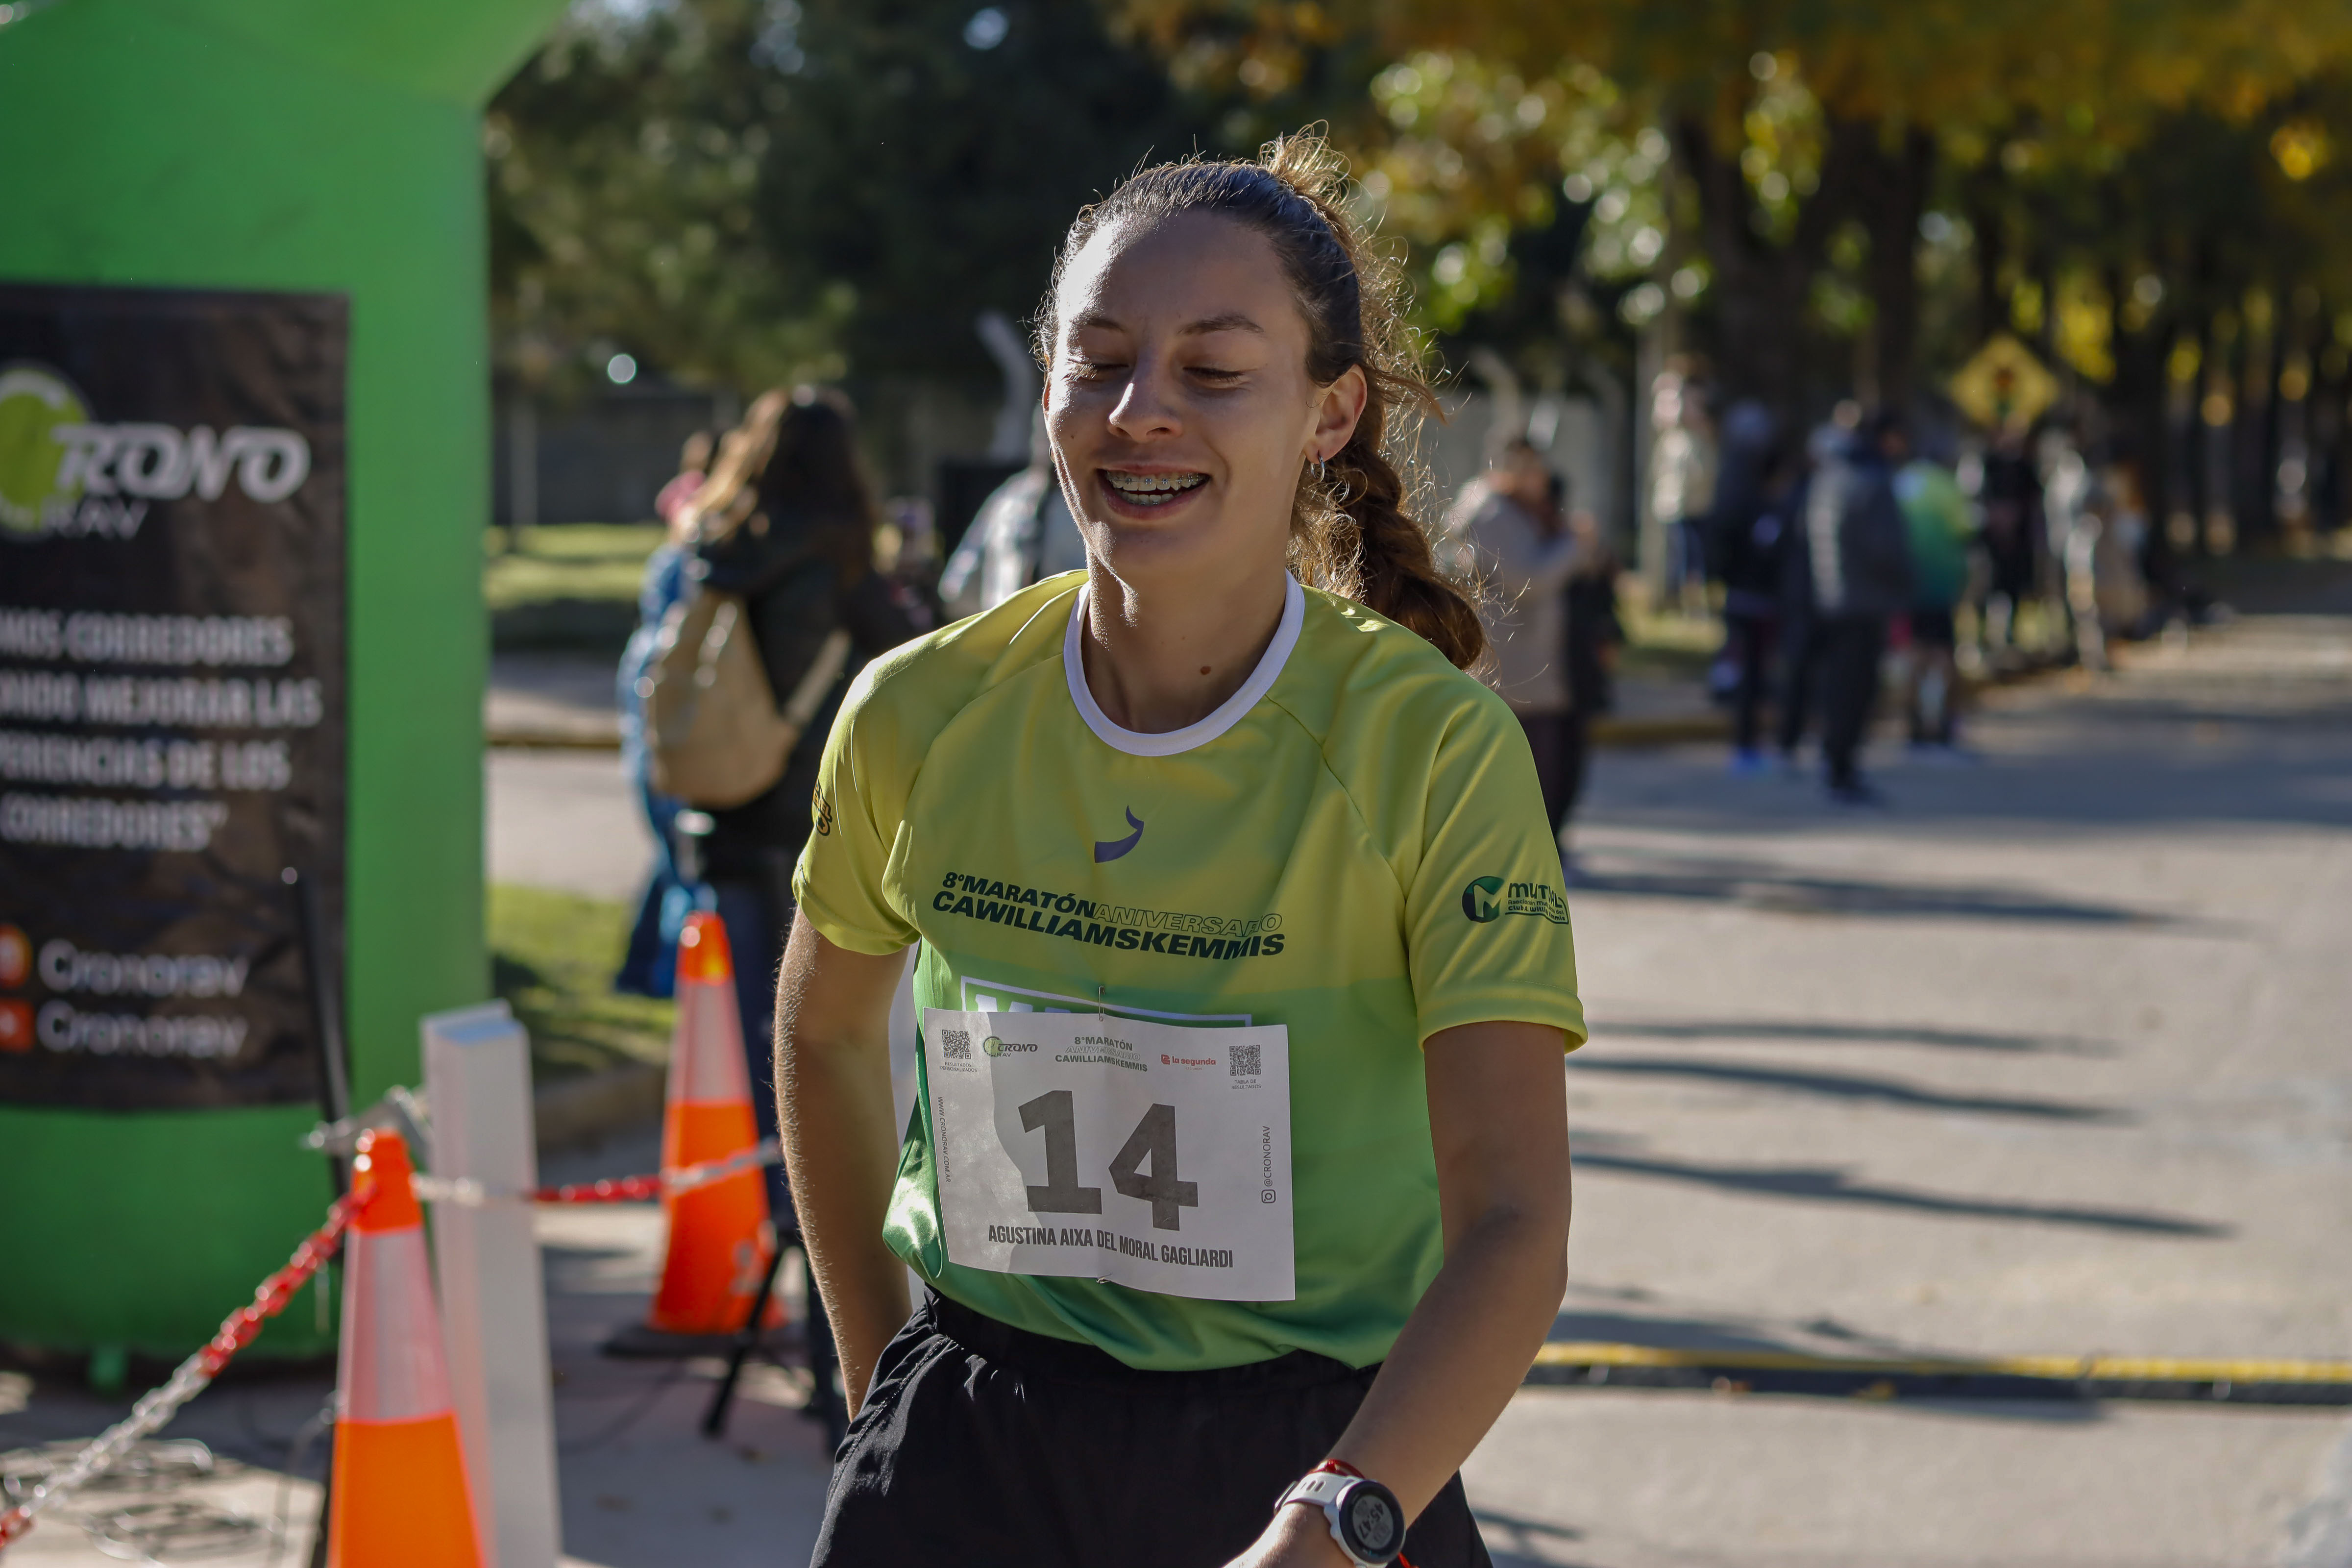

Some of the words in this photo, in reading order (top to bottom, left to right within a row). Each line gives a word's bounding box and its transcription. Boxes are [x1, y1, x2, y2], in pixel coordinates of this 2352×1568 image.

[66, 612, 293, 665] CORREDORES
[86, 676, 251, 725] MEJORAR
[255, 678, 322, 727] LAS
[167, 738, 217, 788] DE
[221, 740, 291, 790] LOS
[932, 891, 1285, 960] CAWILLIAMSKEMMIS
[39, 939, 247, 998] Cronorav
[38, 1000, 246, 1056] Cronorav
[1065, 1046, 1141, 1061] ANIVERSARIO
[1055, 1054, 1148, 1072] CAWILLIAMSKEMMIS
[1181, 1057, 1216, 1066] segunda
[937, 1096, 951, 1183] WWW.CRONORAV.COM.AR
[1018, 1090, 1199, 1231] 14
[1262, 1126, 1271, 1187] @CRONORAV
[988, 1225, 1057, 1246] AGUSTINA
[1060, 1228, 1094, 1247] AIXA
[1097, 1229, 1117, 1251] DEL
[1119, 1235, 1158, 1261] MORAL
[1161, 1245, 1233, 1268] GAGLIARDI
